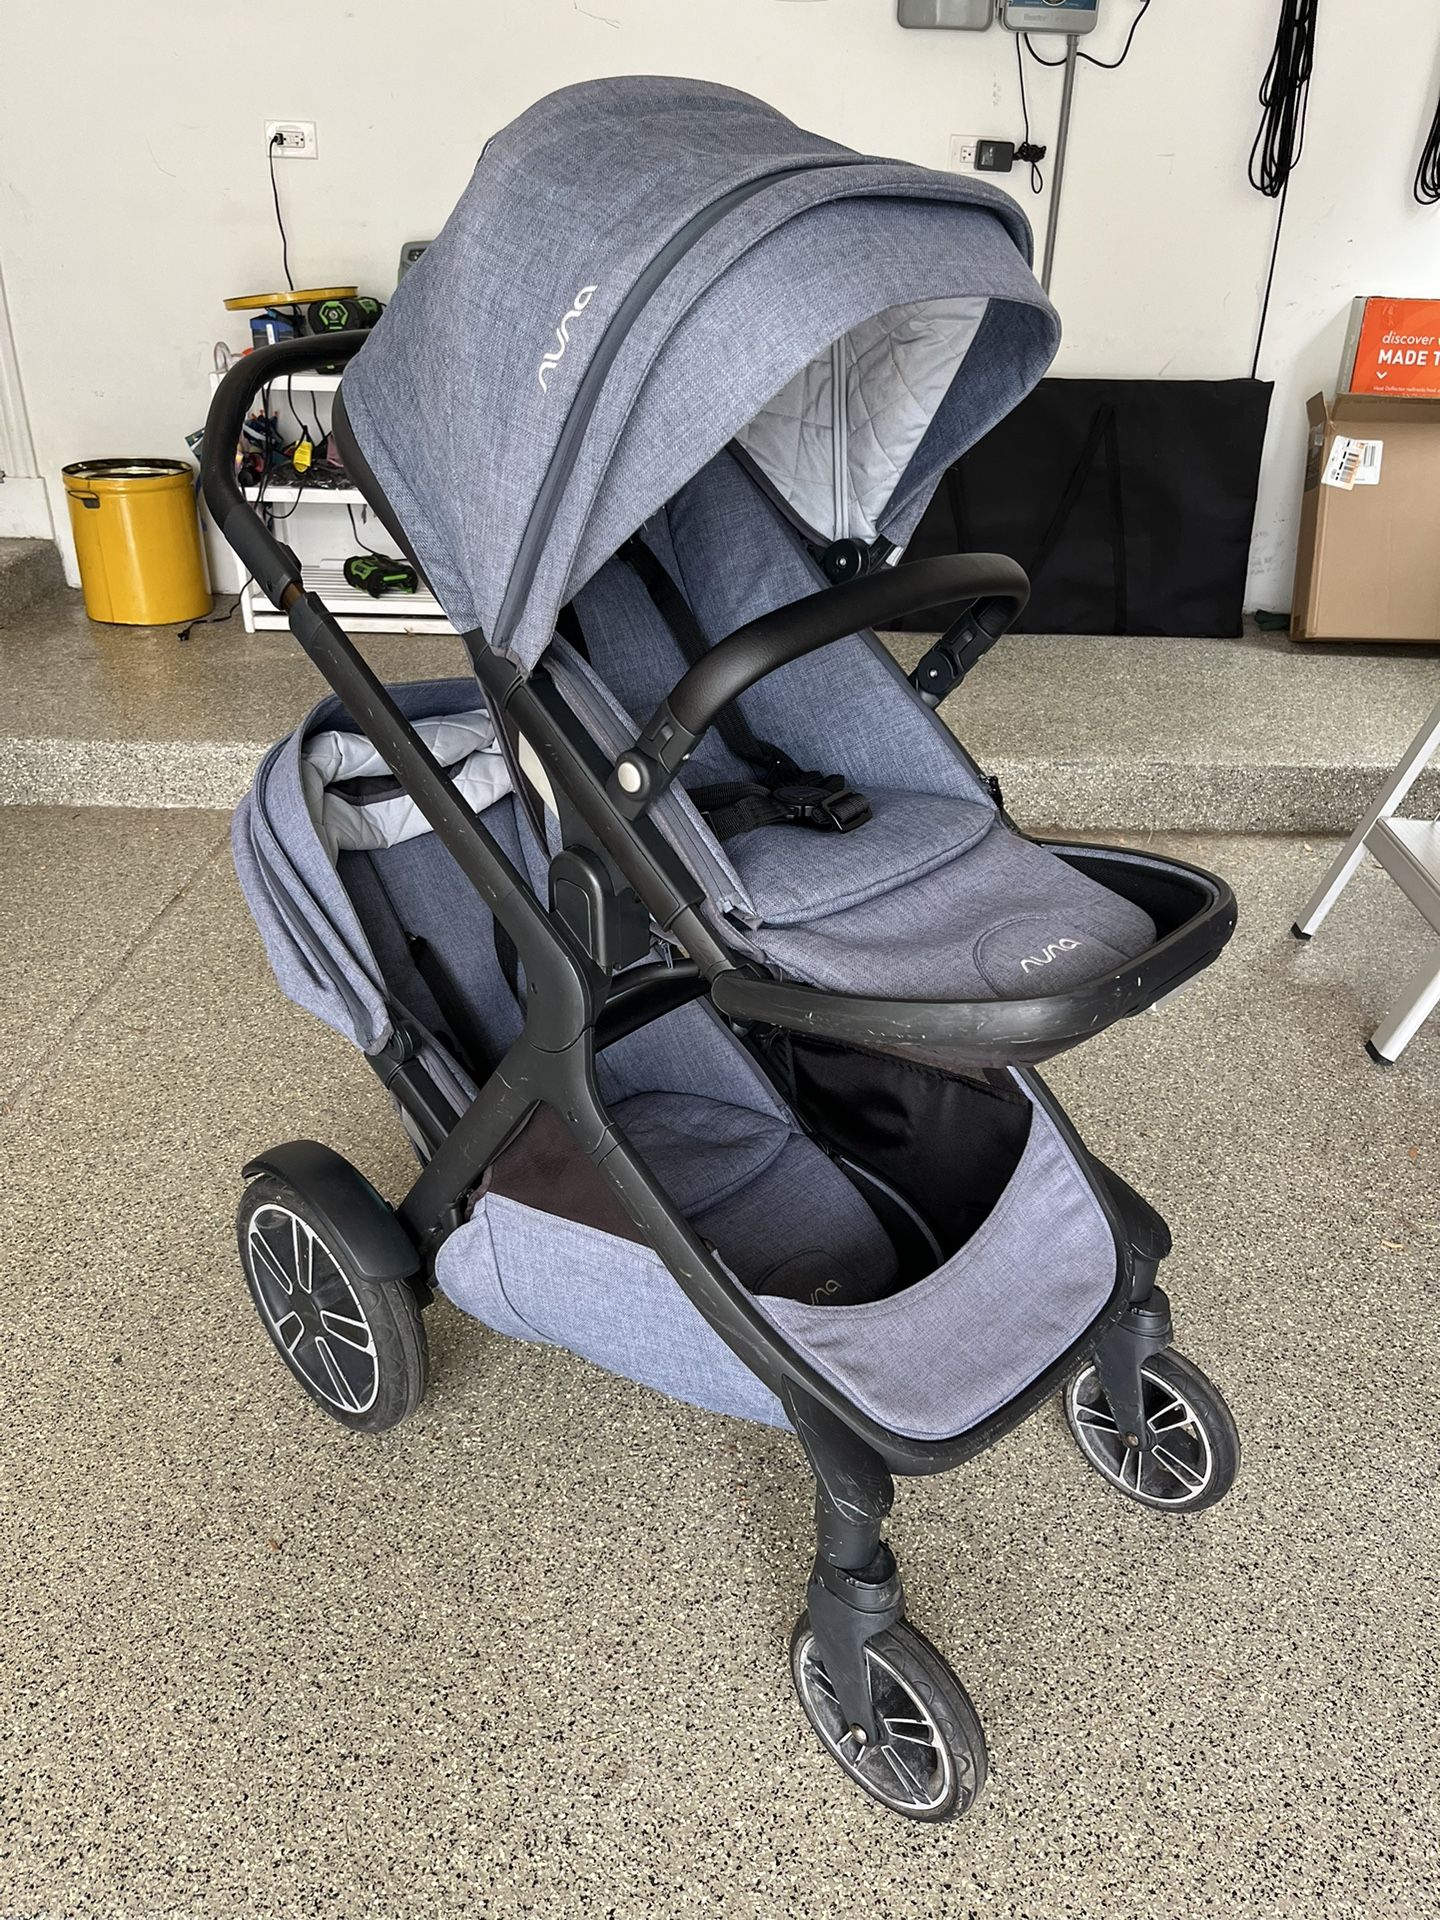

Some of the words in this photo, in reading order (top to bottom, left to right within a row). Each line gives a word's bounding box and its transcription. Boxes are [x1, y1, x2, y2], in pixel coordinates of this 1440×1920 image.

[538, 284, 598, 394] nuna
[1382, 330, 1435, 345] discover
[1377, 349, 1429, 366] MADE
[1020, 938, 1082, 973] nuna
